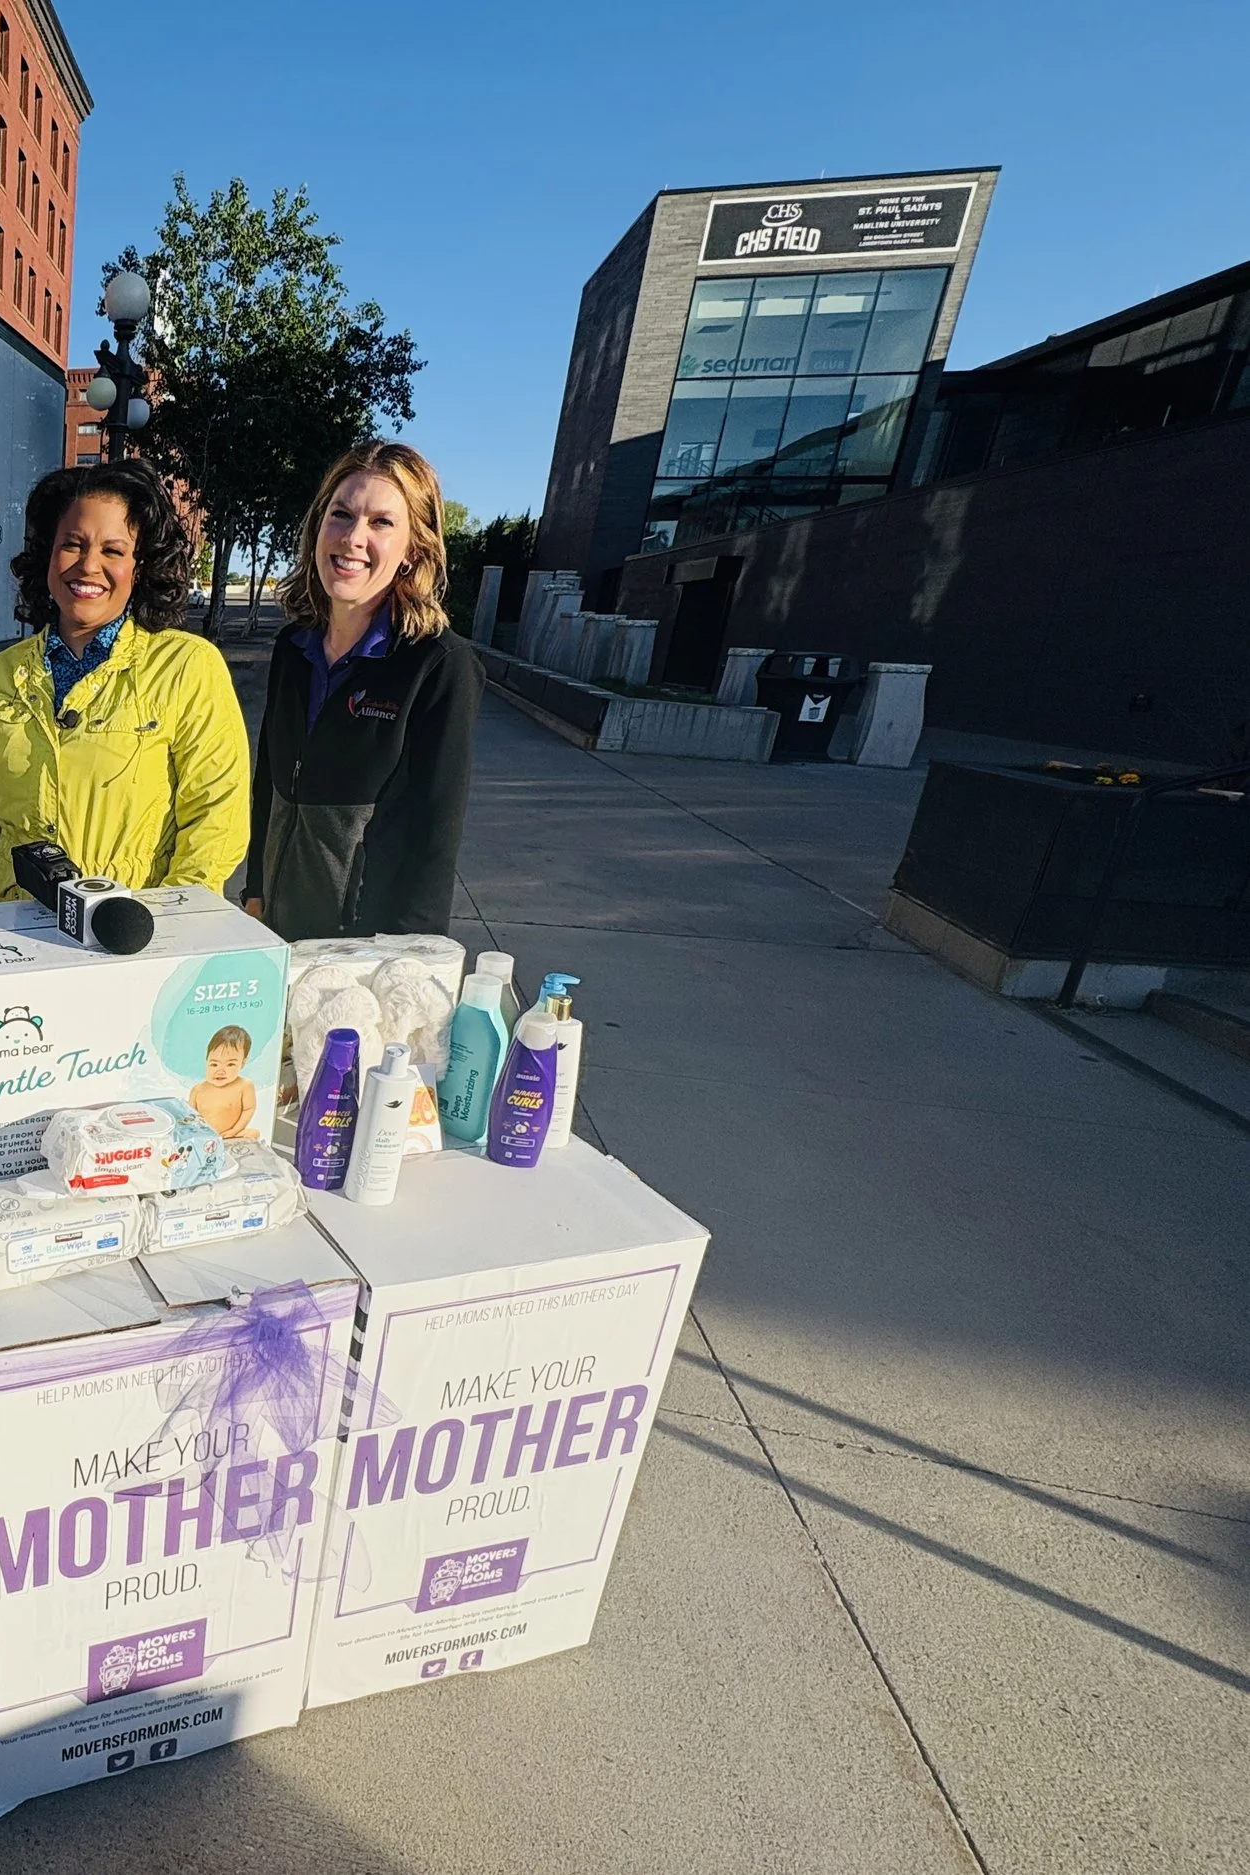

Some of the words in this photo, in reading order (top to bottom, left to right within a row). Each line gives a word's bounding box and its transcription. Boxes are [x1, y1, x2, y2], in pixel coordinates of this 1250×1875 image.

[858, 206, 872, 216] ST.
[875, 205, 901, 214] PAUL
[903, 202, 942, 212] SAINTS
[879, 197, 900, 205] HOME
[768, 203, 800, 219] CHS
[853, 221, 889, 230] HAMLINE
[890, 218, 941, 228] UNIVERSITY
[735, 228, 772, 256] CHS
[774, 226, 821, 252] FIELD
[701, 356, 798, 373] securian
[357, 706, 397, 720] Alliance
[4, 956, 37, 965] bear
[194, 981, 241, 1002] SIZE
[246, 979, 259, 996] 3
[187, 1005, 211, 1015] 16-28
[212, 1004, 225, 1013] lbs
[227, 1001, 247, 1012] (7-13
[250, 1000, 263, 1009] kg)
[23, 1043, 54, 1056] bear
[56, 1042, 147, 1082] Touch
[516, 1073, 541, 1082] aussie
[460, 1069, 479, 1121] Moisturizing
[507, 1095, 544, 1109] CURLS
[513, 1089, 542, 1098] MIRACLE
[451, 1095, 462, 1118] Deep
[318, 1116, 352, 1128] CURLS
[10, 1132, 34, 1141] FROM
[94, 1146, 152, 1165] HUGGIES
[94, 1166, 121, 1174] simply
[122, 1163, 143, 1172] clean
[424, 1313, 455, 1332] HELP
[455, 1307, 491, 1326] MOMS
[492, 1305, 504, 1319] IN
[505, 1300, 535, 1318] NEED
[536, 1295, 560, 1313] THIS
[561, 1287, 615, 1308] MOTHER'S
[616, 1282, 641, 1299] DAY.
[36, 1386, 71, 1407] HELP
[72, 1378, 114, 1400] MOMS
[115, 1375, 129, 1391] IN
[131, 1369, 164, 1388] NEED
[168, 1362, 195, 1382] THIS
[440, 1367, 521, 1410] MAKE
[530, 1355, 598, 1393] YOUR
[73, 1441, 163, 1488] MAKE
[173, 1422, 251, 1466] YOUR
[346, 1384, 650, 1511] MOTHER
[445, 1485, 531, 1527] PROUD.
[465, 1547, 518, 1565] MOVERS
[461, 1568, 503, 1586] MOMS
[464, 1561, 491, 1576] FOR
[104, 1563, 203, 1611] PROUD.
[137, 1628, 197, 1651] MOVERS
[384, 1622, 528, 1666] MOVERSFORMOMS.COM
[136, 1651, 184, 1673] MOMS
[137, 1646, 168, 1661] FOR
[61, 1707, 224, 1762] MOVERSFORMOMS.COM
